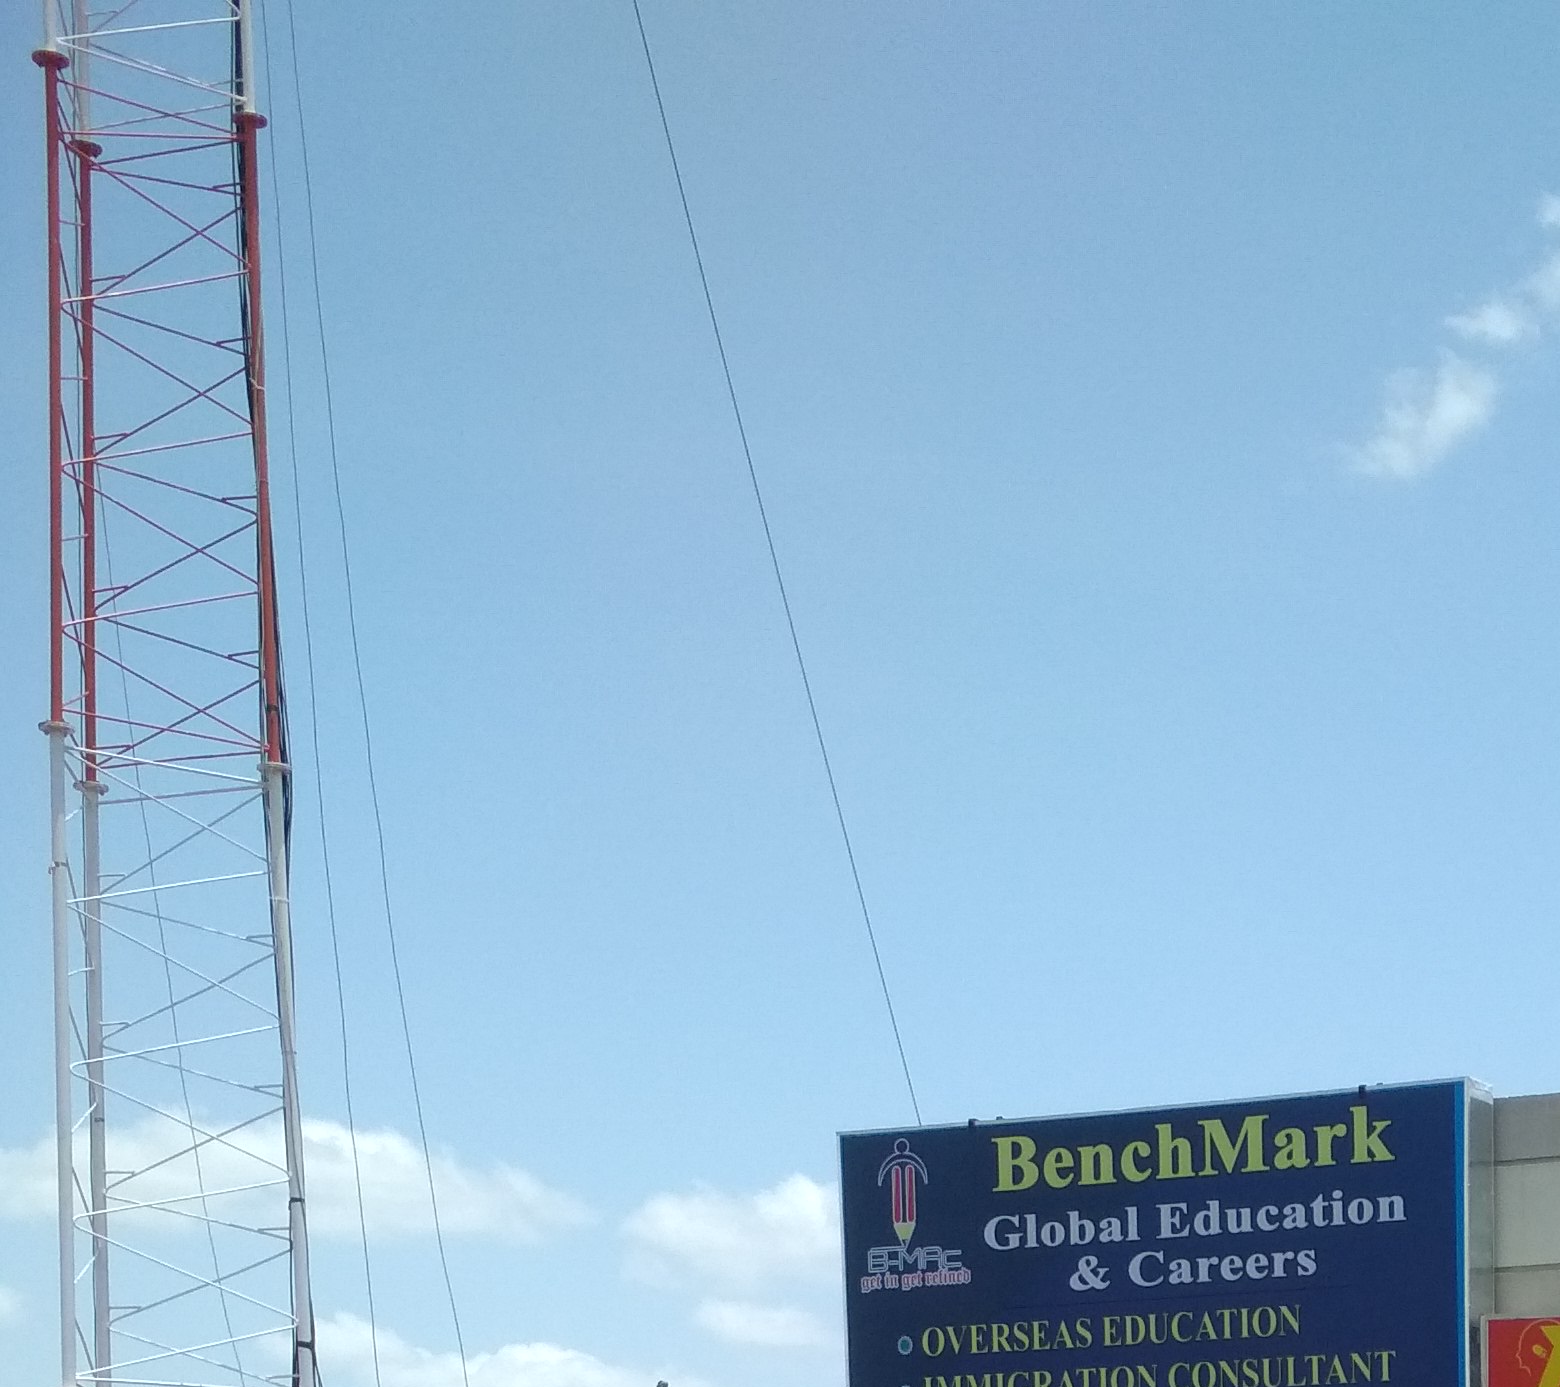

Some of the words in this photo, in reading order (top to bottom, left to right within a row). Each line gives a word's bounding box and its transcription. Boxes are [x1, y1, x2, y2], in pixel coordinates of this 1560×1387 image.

[991, 1106, 1395, 1192] BenchMark
[984, 1208, 1140, 1250] Global
[1156, 1191, 1407, 1240] Education
[1069, 1256, 1111, 1291] &
[1128, 1250, 1317, 1285] Careers
[921, 1318, 1093, 1356] OVERSEAS
[1103, 1305, 1301, 1347] EDUCATION
